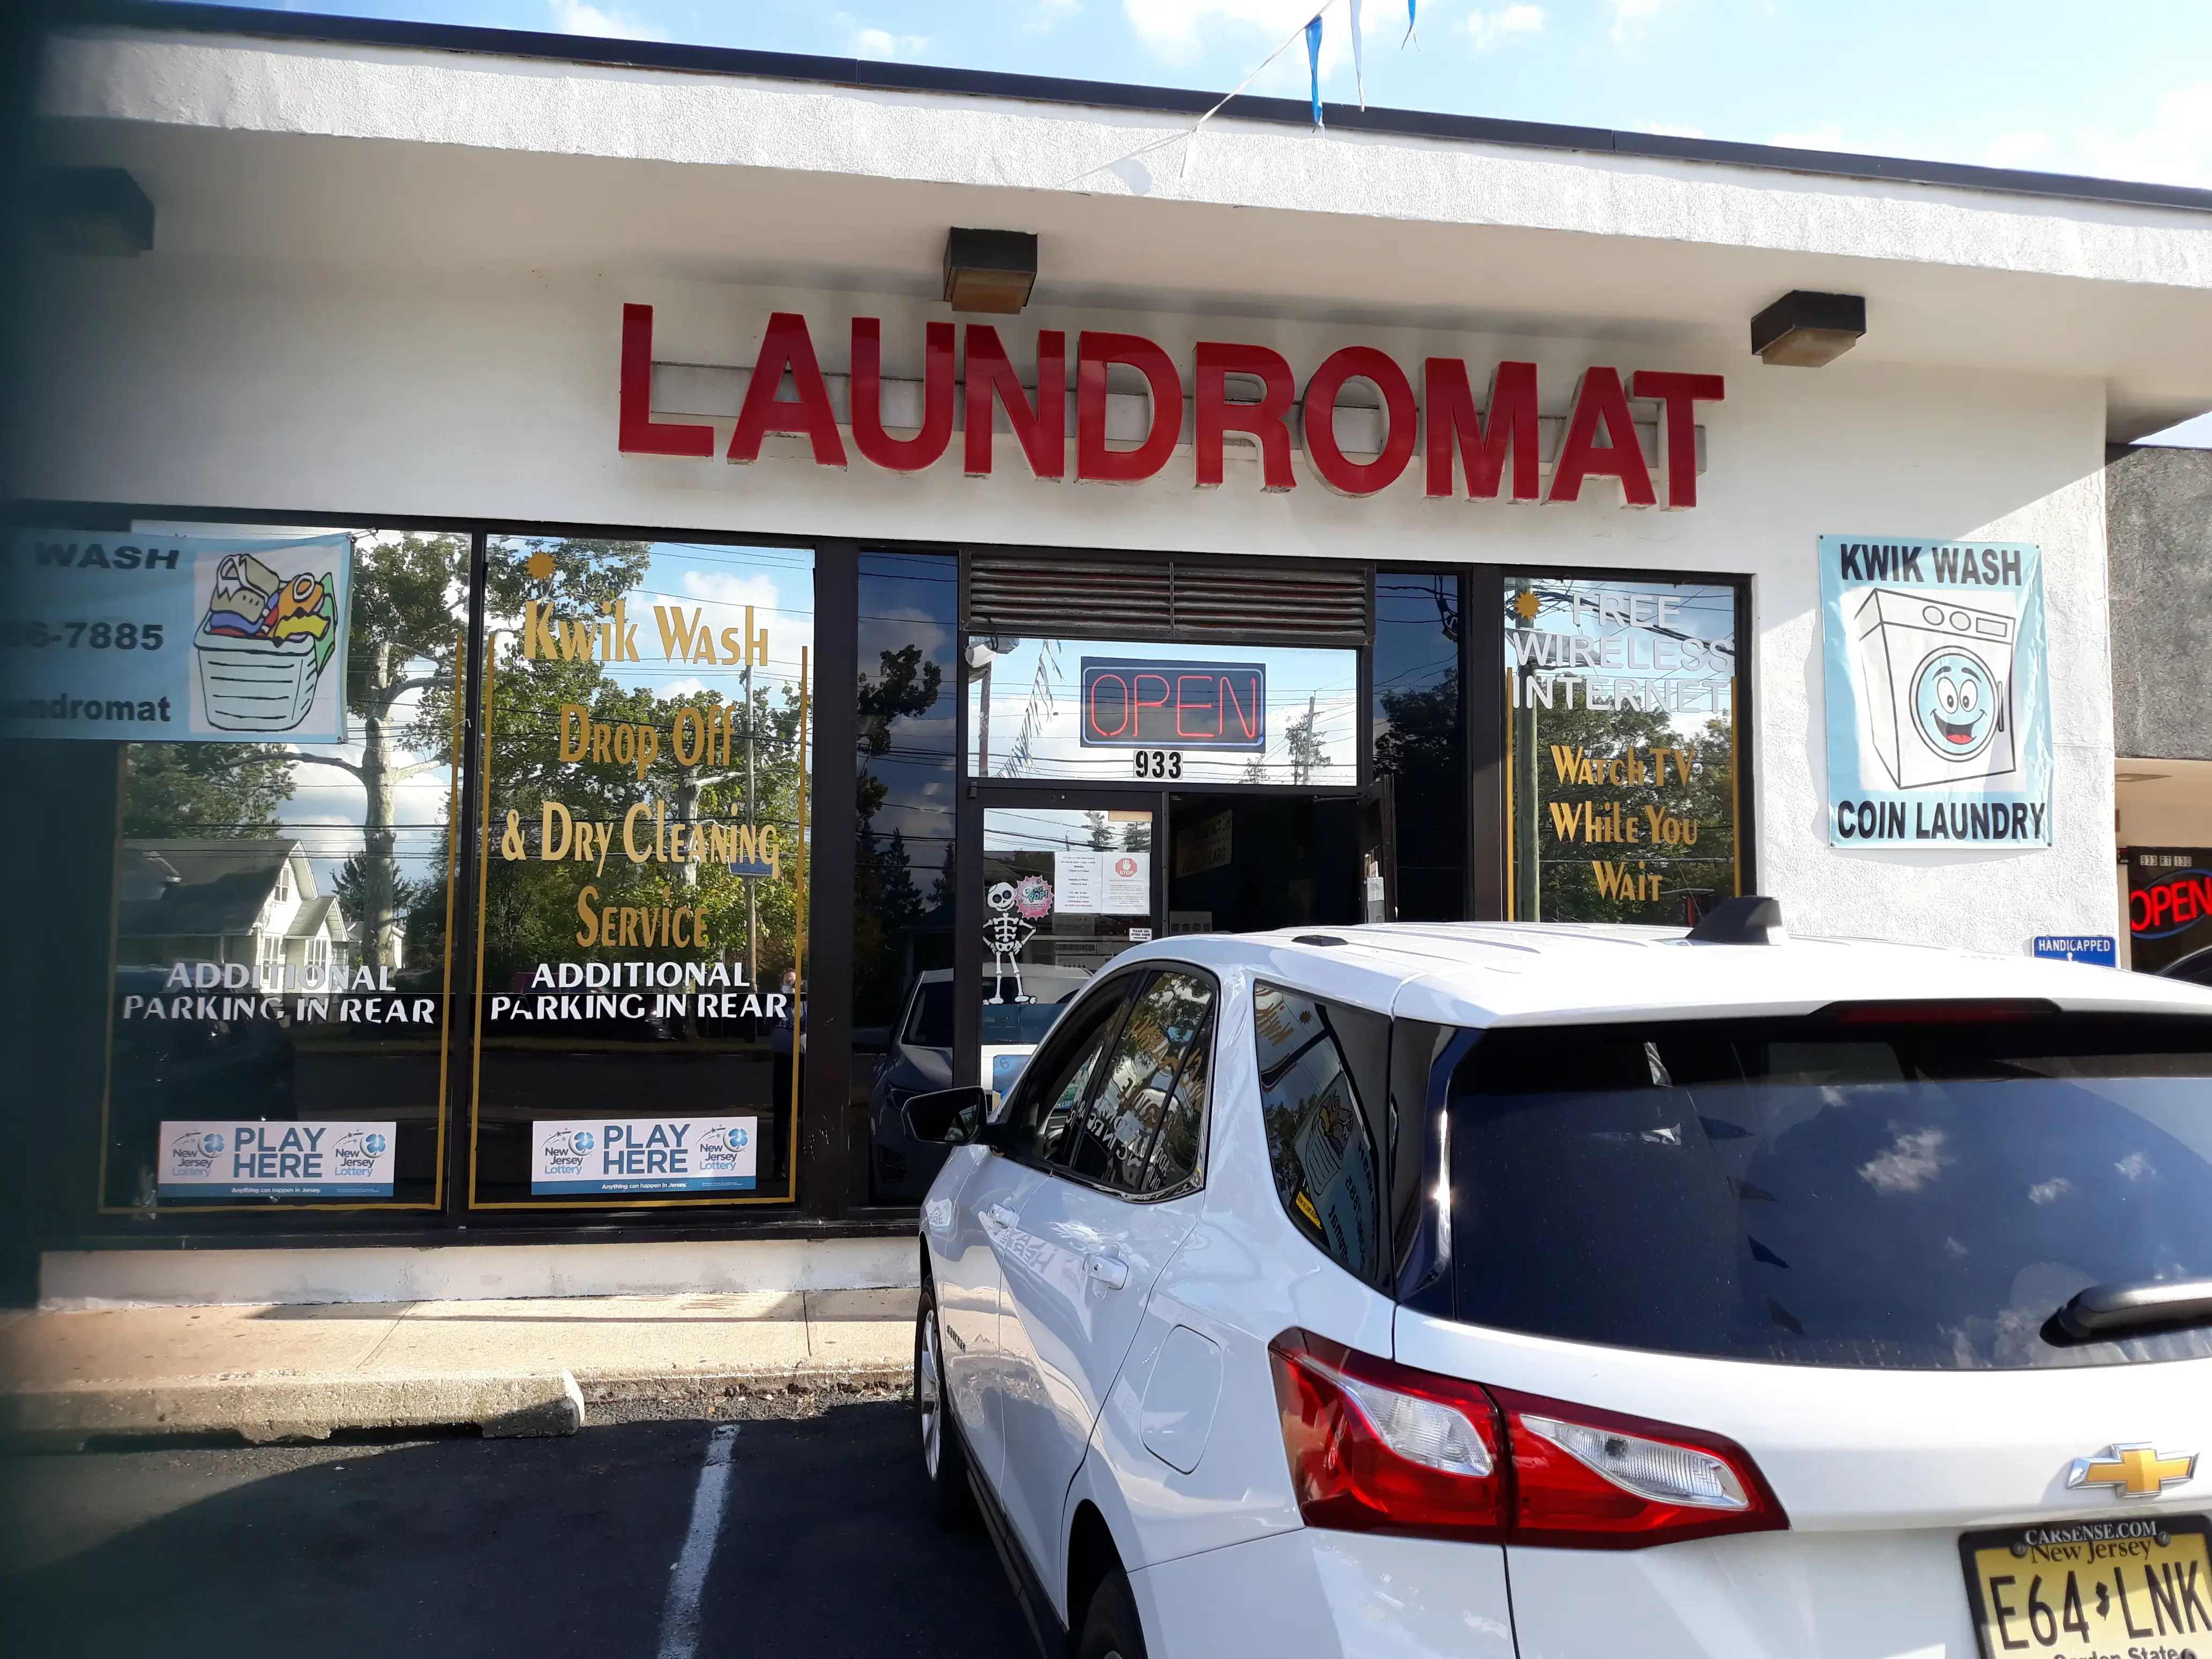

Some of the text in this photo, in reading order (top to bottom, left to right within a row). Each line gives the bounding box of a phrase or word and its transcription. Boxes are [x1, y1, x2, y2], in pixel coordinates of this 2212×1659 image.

[618, 302, 1725, 510] LAUNDROMAT
[33, 540, 180, 570] WASH
[1840, 542, 2022, 586] KWIK WASH
[1573, 591, 1682, 630] FREE
[1513, 632, 1737, 672] WIRELESS
[1090, 672, 1257, 738] OPEN
[1512, 674, 1728, 714] INTERNET
[1134, 751, 1183, 779] 933
[1649, 749, 1695, 787] TV
[1837, 799, 2046, 842] COIN LAUNDRY
[501, 808, 526, 861] &
[1027, 890, 1049, 903] POP!
[2129, 877, 2212, 931] OPEN
[2038, 939, 2111, 952] HANDICAPPED
[166, 961, 396, 992] ADDITIONAL
[530, 961, 751, 989] ADDITIONAL
[122, 994, 435, 1025] PARKING IN REAR
[490, 993, 788, 1020] PARKING IN REAR
[234, 1127, 327, 1152] PLAY
[603, 1123, 691, 1150] PLAY
[699, 1143, 724, 1153] New
[173, 1148, 198, 1158] New
[177, 1158, 214, 1169] Jersey
[233, 1153, 324, 1178] HERE
[335, 1148, 360, 1158] New
[340, 1158, 376, 1169] Jersey
[544, 1147, 569, 1157] New
[549, 1156, 584, 1166] Jersey
[602, 1148, 689, 1175] HERE
[704, 1152, 738, 1162] Jersey
[172, 1167, 211, 1177] Lottery
[334, 1167, 373, 1177] Lottery
[544, 1165, 582, 1175] Lottery
[699, 1161, 737, 1171] Lottery
[2024, 1520, 2158, 1545] CARSENSE.COM
[2030, 1536, 2151, 1565] New Jersey
[1989, 1559, 2212, 1651] E64 LNK
[2127, 1645, 2178, 1659] State
